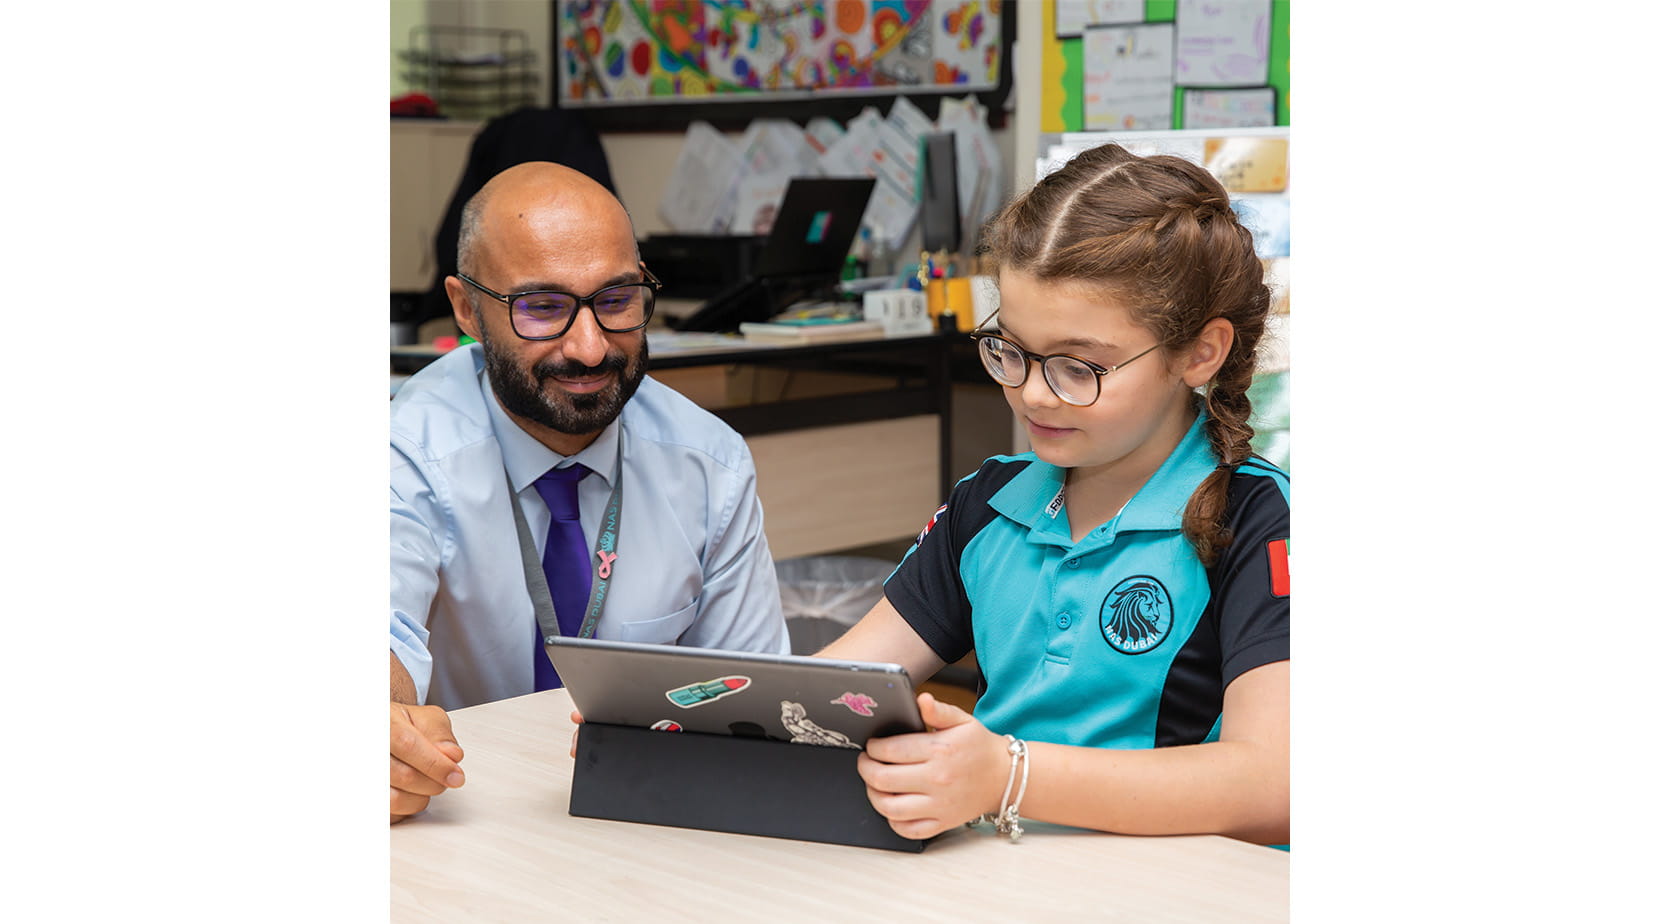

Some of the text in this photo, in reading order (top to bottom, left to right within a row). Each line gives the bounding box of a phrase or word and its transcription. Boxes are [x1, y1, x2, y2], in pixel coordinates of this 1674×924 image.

[607, 507, 618, 530] NAS
[591, 581, 606, 617] DUBAI
[1104, 624, 1159, 650] NAS DUBAI
